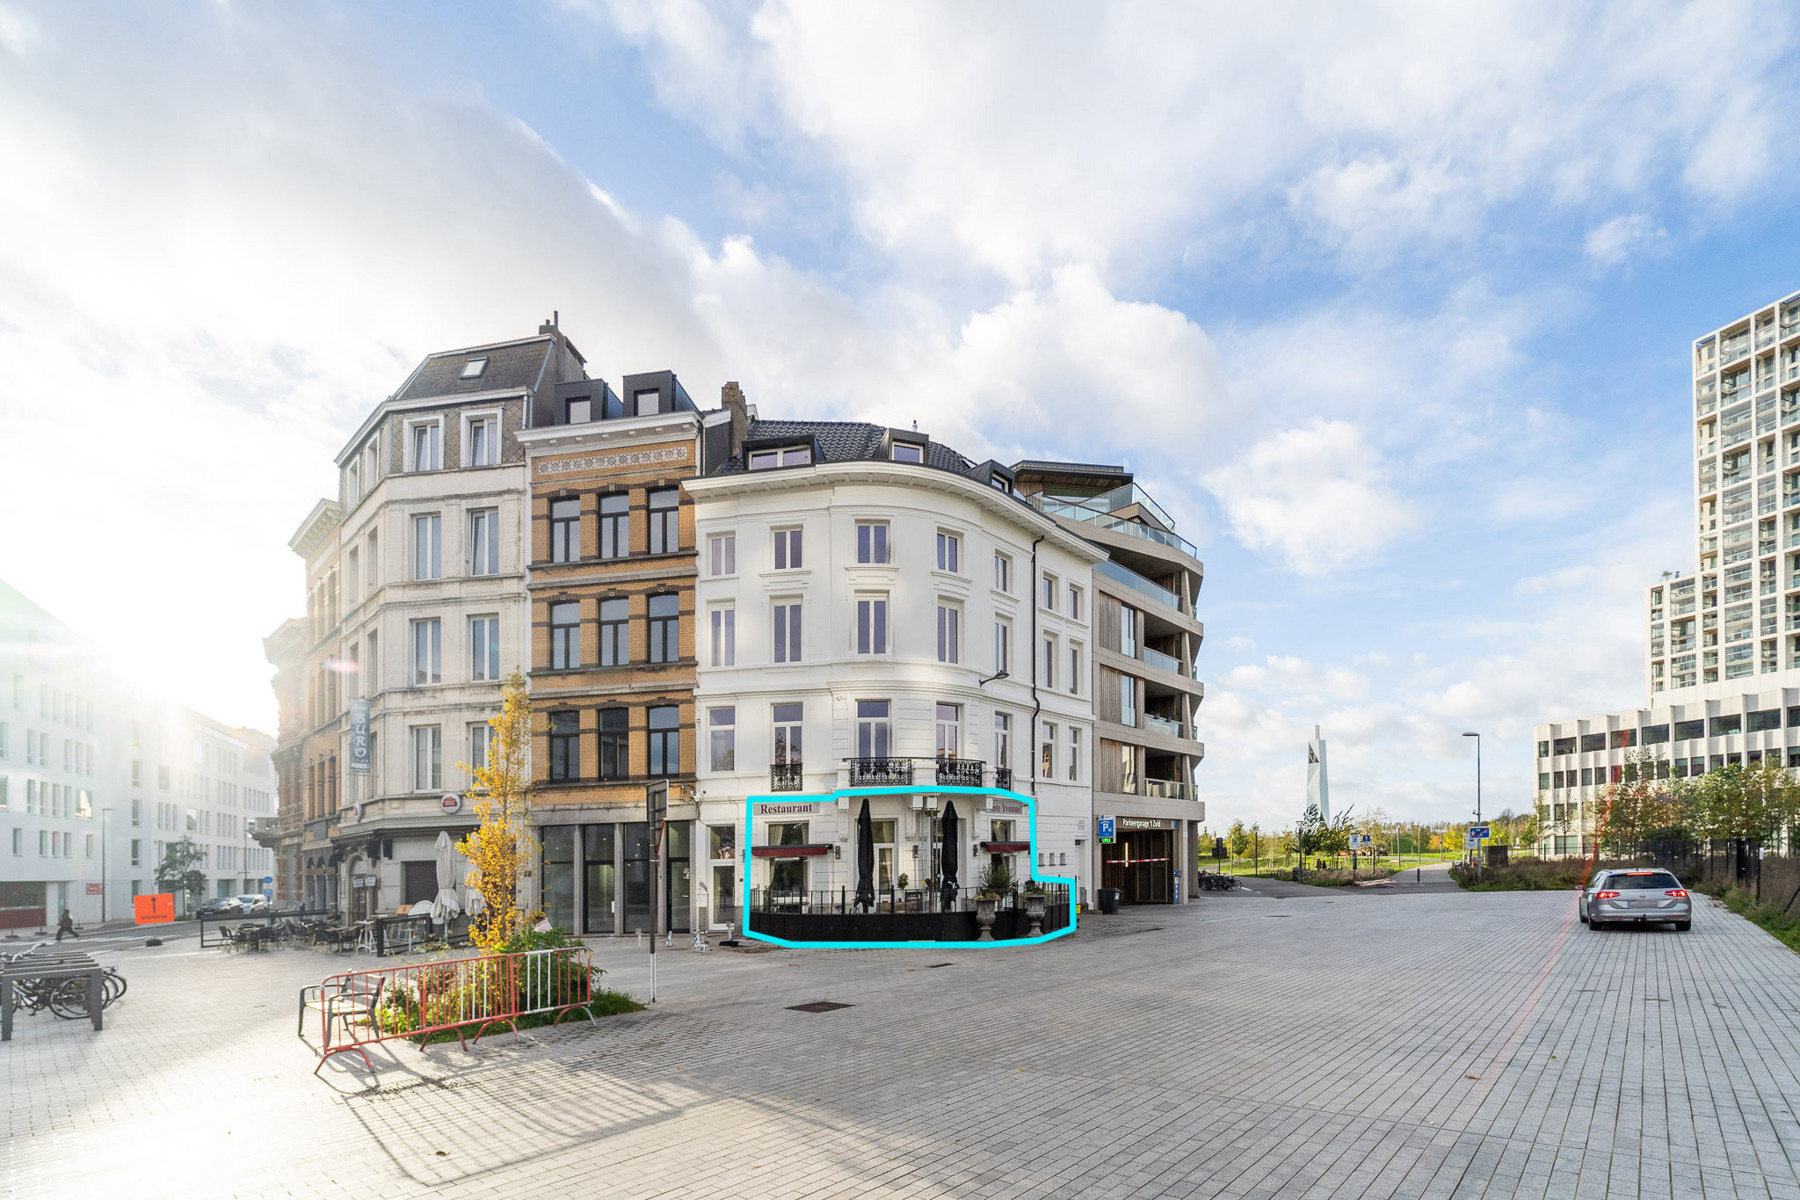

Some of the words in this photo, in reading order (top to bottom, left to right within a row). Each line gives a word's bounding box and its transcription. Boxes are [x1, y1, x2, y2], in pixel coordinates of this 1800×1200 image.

[760, 803, 813, 814] Restaurant
[1002, 804, 1020, 812] Yvonne
[1102, 823, 1108, 832] P
[1122, 818, 1149, 828] Parkeergarage
